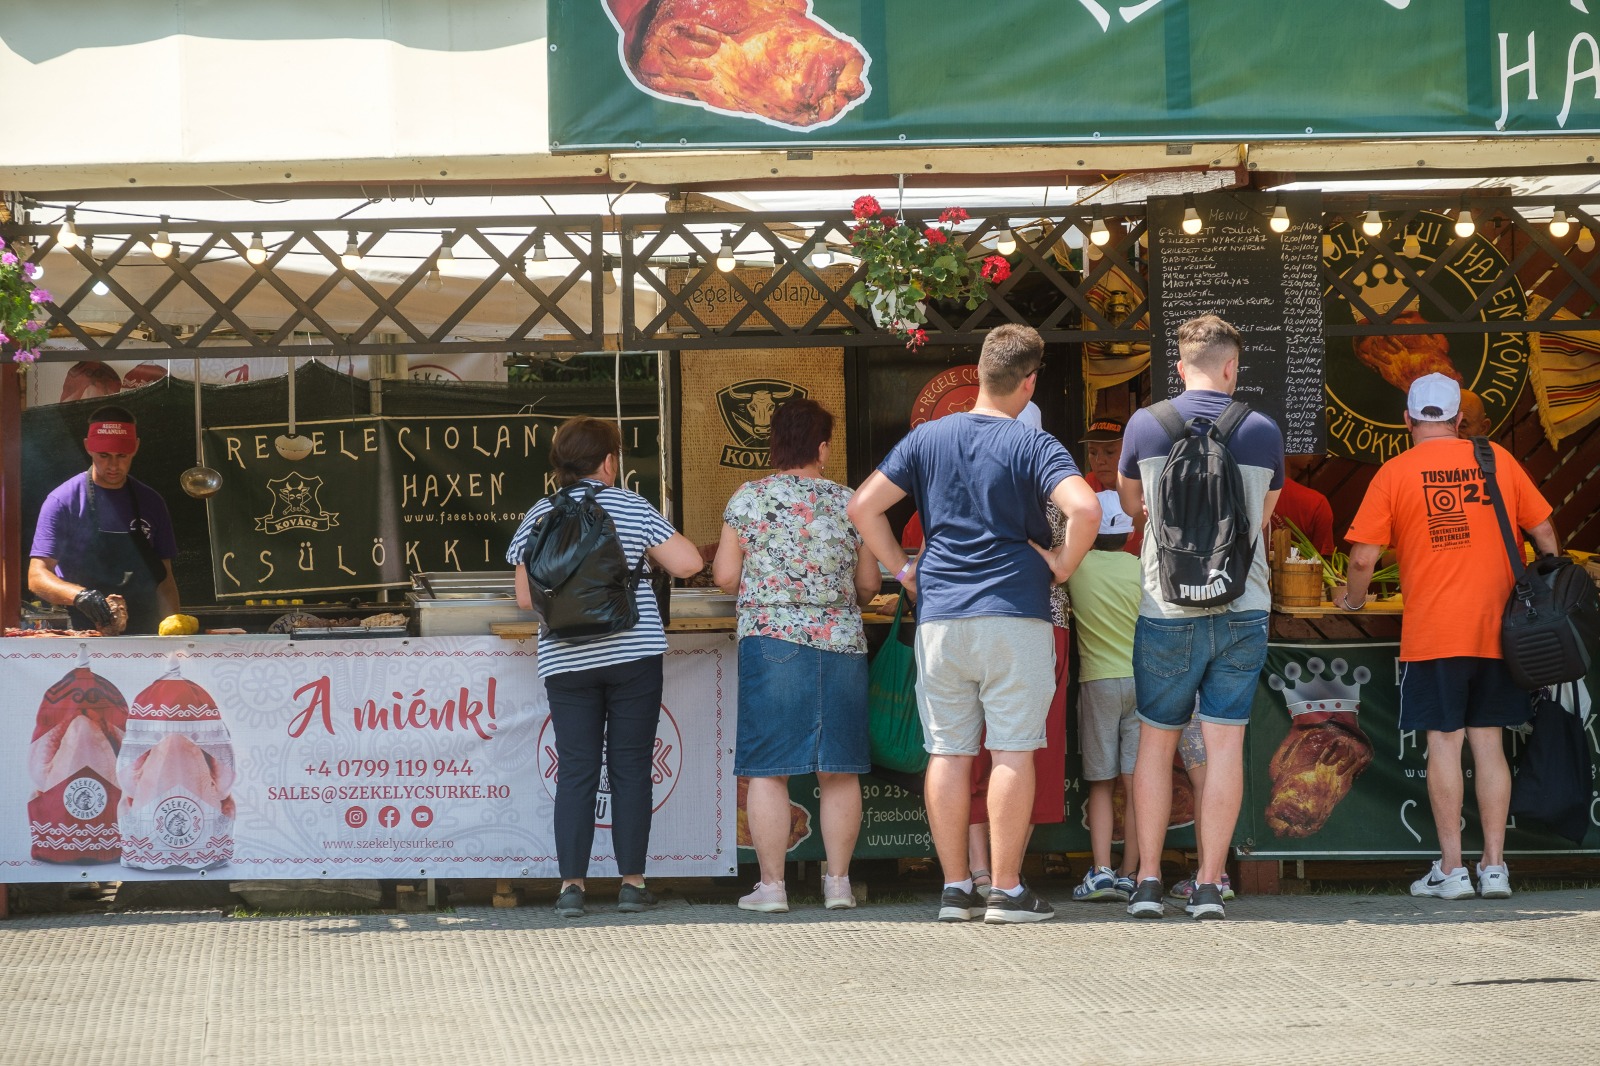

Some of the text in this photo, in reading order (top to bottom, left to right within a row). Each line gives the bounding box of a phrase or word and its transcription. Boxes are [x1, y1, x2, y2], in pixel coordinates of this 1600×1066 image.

[1208, 208, 1248, 221] MENIU
[920, 371, 958, 406] REGELE
[226, 428, 378, 469] REELE
[402, 472, 505, 508] HAXEN
[275, 516, 319, 531] KOVÁCS
[1180, 578, 1227, 601] PUMA
[287, 675, 498, 741] A miénk!
[305, 759, 474, 778] +4 0799 119 944
[267, 785, 511, 803] SALES@SZEKELYCSURKE.RO
[161, 799, 197, 814] SZÉKELY
[322, 838, 454, 851] www.szekelycsurke.ro
